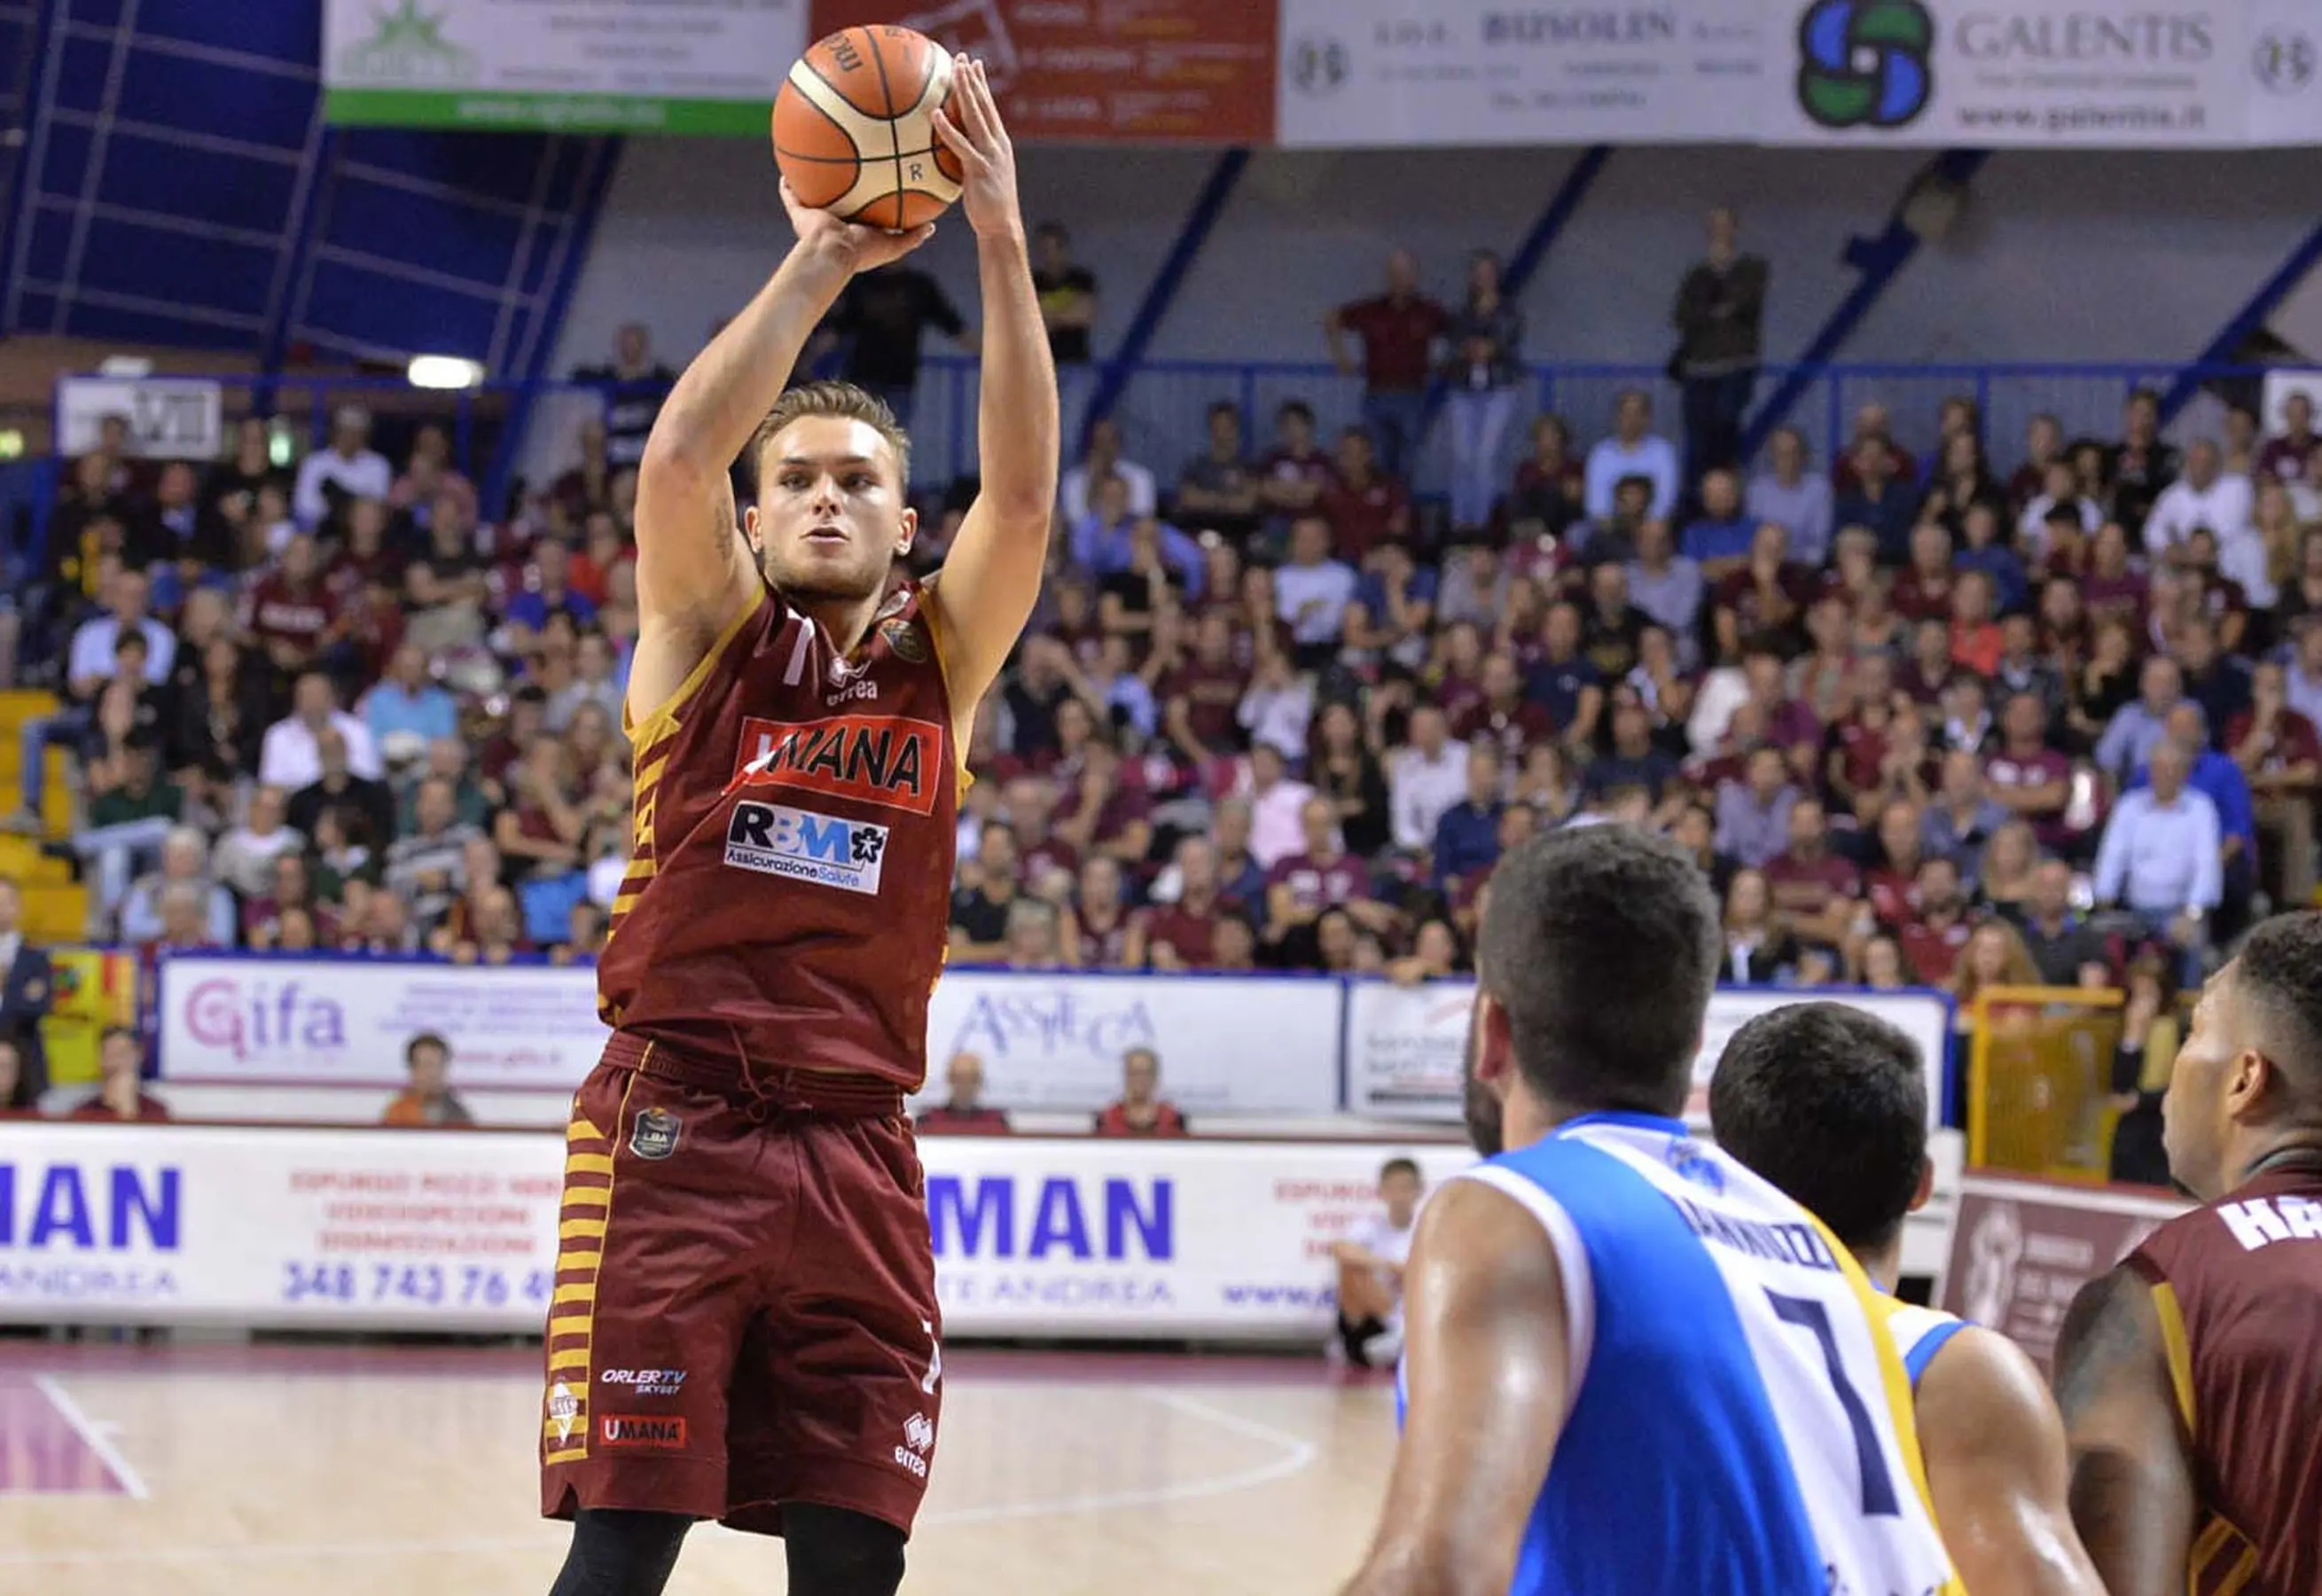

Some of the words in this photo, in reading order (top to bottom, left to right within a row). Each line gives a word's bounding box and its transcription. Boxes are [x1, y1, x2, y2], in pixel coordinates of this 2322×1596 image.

[1954, 12, 2215, 60] GALENTIS
[910, 163, 924, 182] R
[729, 802, 851, 864] RBM
[185, 981, 348, 1064] Gifa
[927, 1177, 1173, 1260] MAN
[605, 1418, 679, 1441] UMANA
[1760, 1284, 1901, 1517] 7
